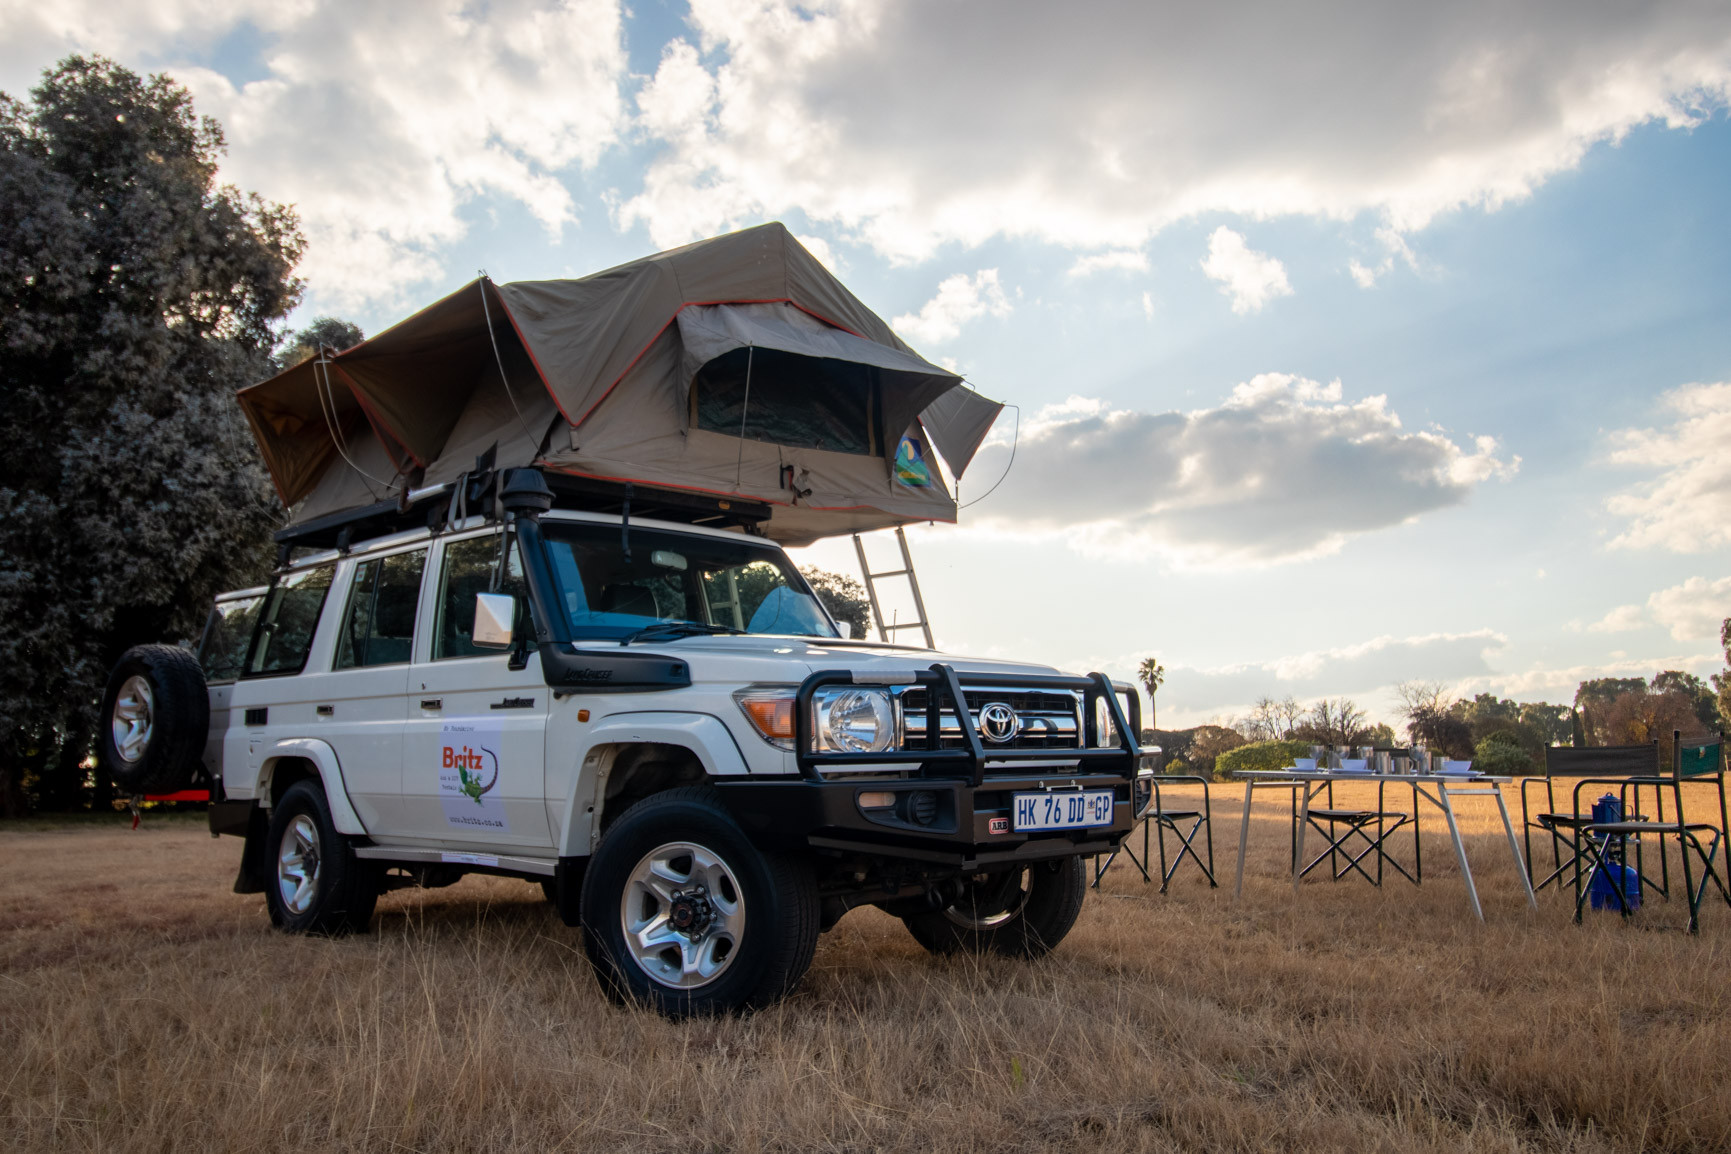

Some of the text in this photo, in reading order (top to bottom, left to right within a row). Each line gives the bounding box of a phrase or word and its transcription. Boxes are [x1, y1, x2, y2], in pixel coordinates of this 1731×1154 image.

[443, 745, 483, 770] Britz
[1018, 796, 1110, 826] HK 76 DD GP
[992, 821, 1008, 830] ARB
